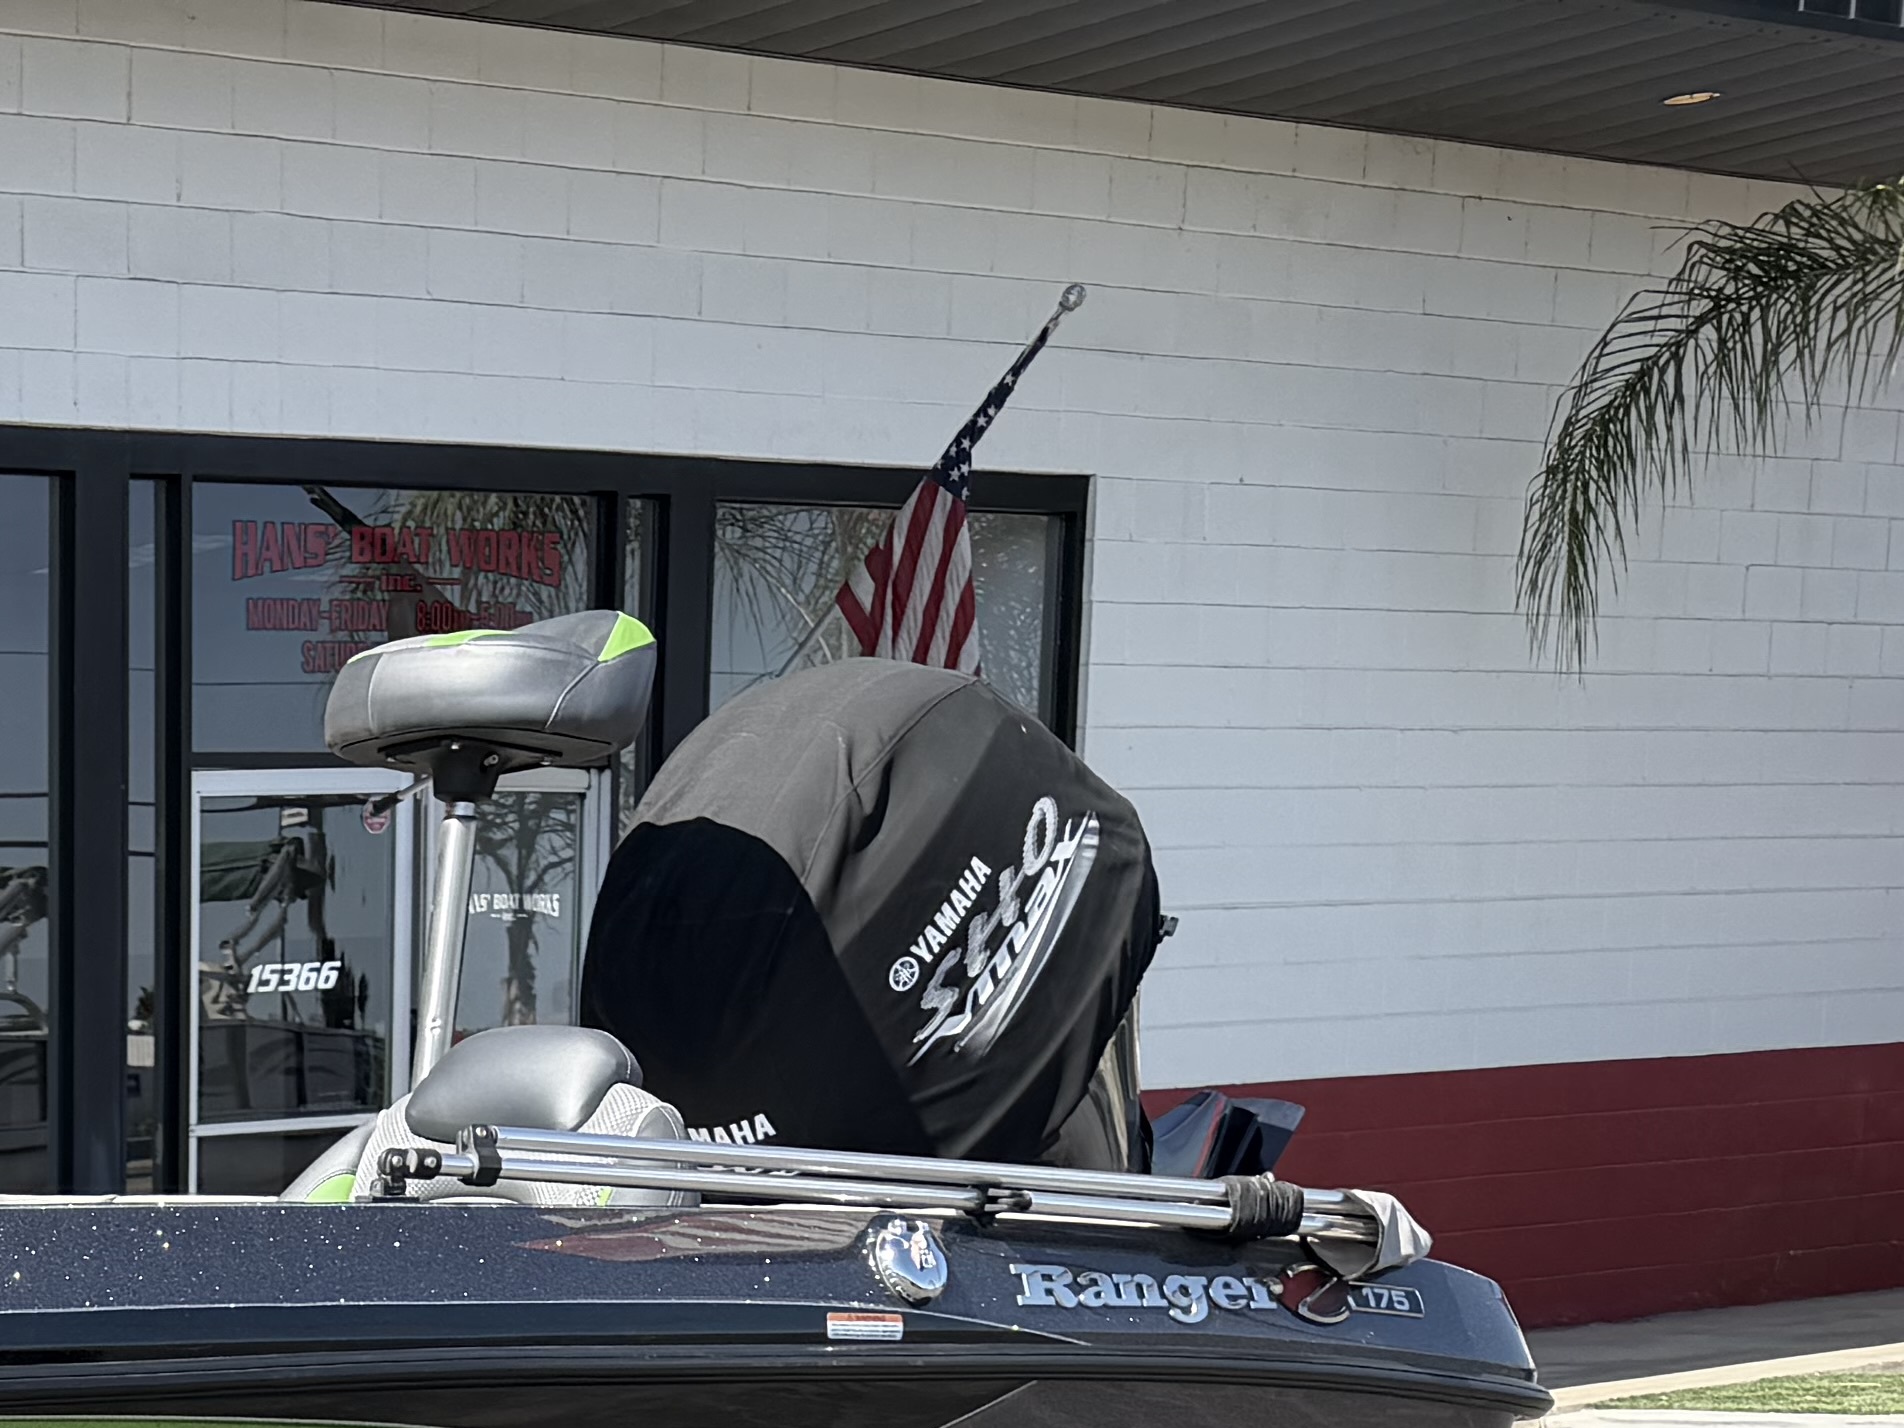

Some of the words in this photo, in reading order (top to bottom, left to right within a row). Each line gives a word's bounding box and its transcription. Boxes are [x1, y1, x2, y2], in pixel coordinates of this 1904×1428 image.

[232, 520, 337, 581] HANS'
[351, 526, 434, 564] BOAT
[448, 528, 561, 587] WORKS
[910, 856, 992, 963] YAMAHA
[246, 960, 341, 993] 15366
[687, 1113, 776, 1145] MAHA
[1009, 1263, 1281, 1324] Ranger
[1362, 1286, 1410, 1311] 175
